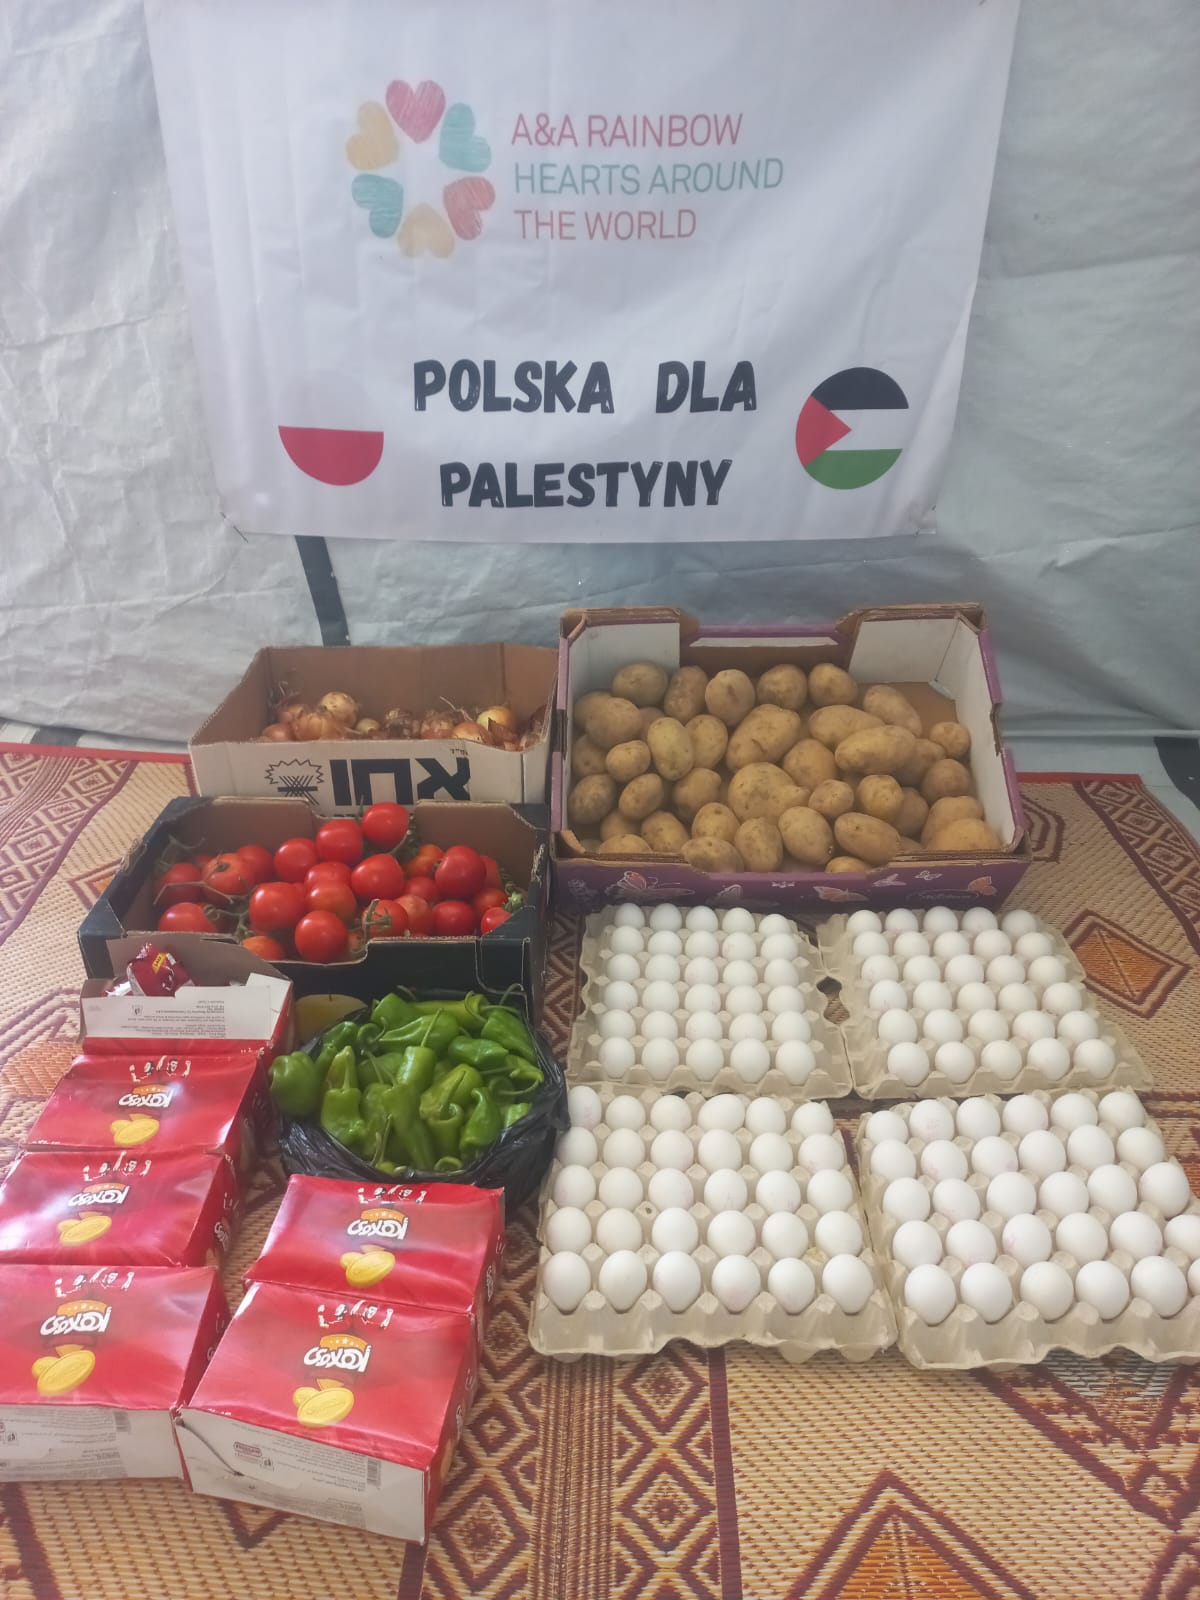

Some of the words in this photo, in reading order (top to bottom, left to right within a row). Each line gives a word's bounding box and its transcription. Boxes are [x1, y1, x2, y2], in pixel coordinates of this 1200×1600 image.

[511, 112, 579, 148] A&A
[586, 112, 744, 148] RAINBOW
[513, 162, 641, 196] HEARTS
[648, 157, 785, 195] AROUND
[514, 209, 577, 241] THE
[585, 208, 697, 241] WORLD
[413, 359, 615, 414] POLSKA
[655, 360, 758, 413] DLA
[440, 458, 734, 508] PALESTYNY
